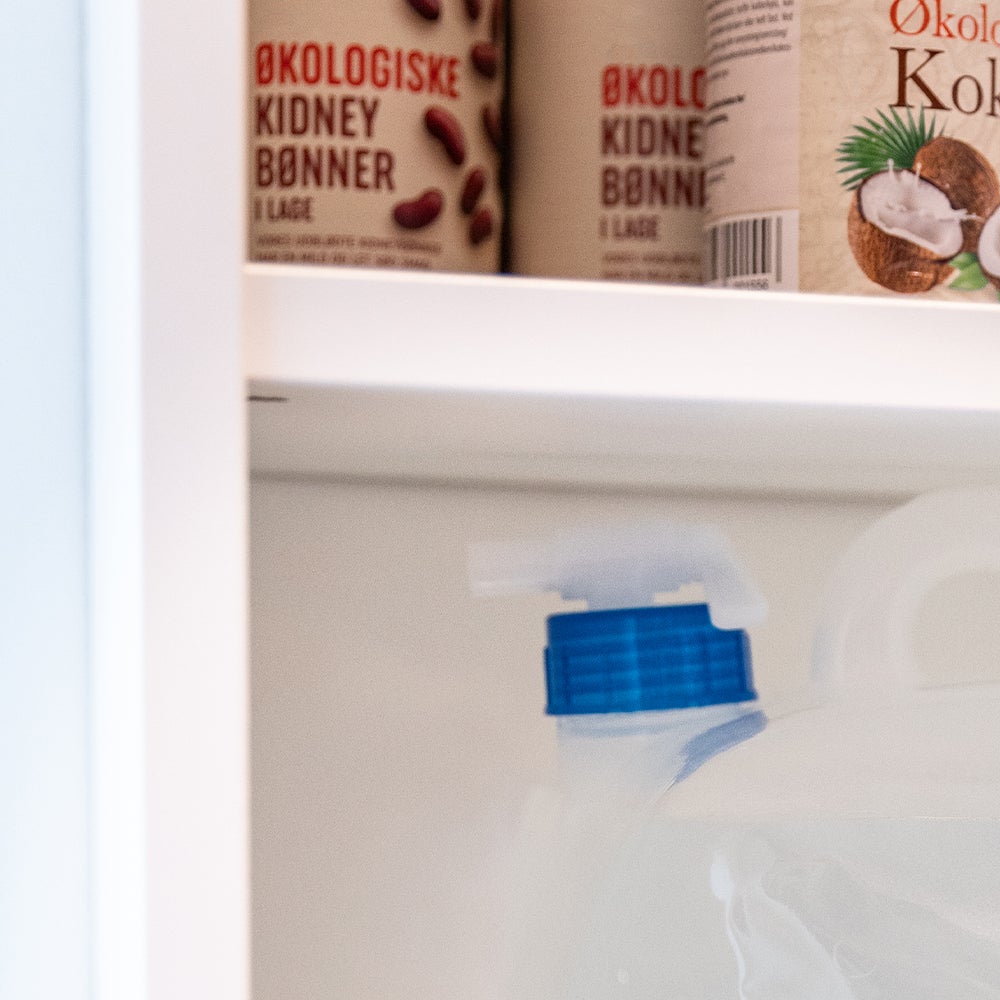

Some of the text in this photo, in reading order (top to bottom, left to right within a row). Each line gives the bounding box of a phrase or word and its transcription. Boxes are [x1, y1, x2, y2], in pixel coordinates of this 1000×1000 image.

[255, 41, 460, 99] ØKOLOGISKE
[255, 95, 379, 138] KIDNEY
[256, 146, 397, 191] BØNNER
